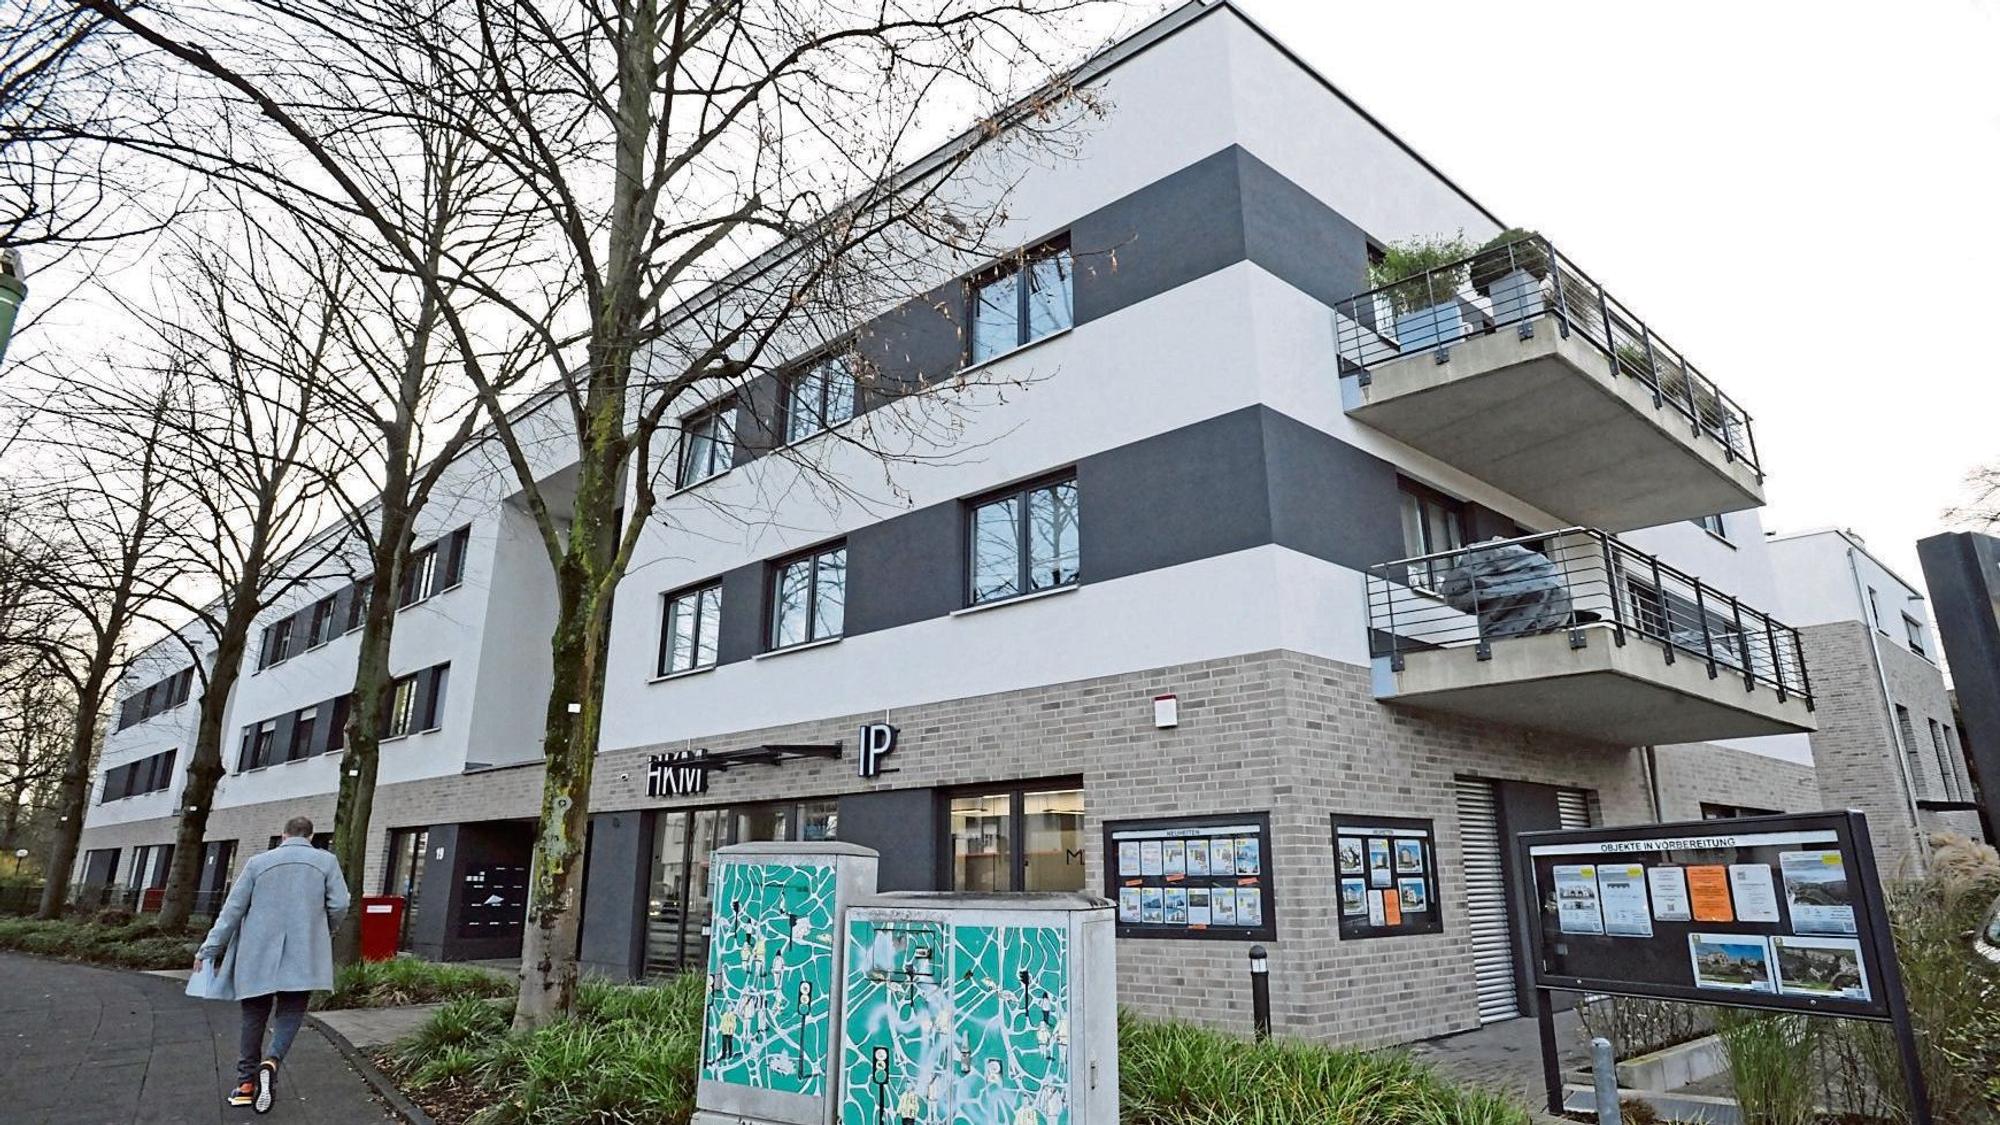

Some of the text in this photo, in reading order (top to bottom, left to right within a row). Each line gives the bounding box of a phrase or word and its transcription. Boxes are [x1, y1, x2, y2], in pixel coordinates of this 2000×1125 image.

[646, 749, 702, 795] HKM
[859, 724, 892, 775] IP
[1600, 837, 1736, 852] OBJEKTE IN VORBEREITUNG
